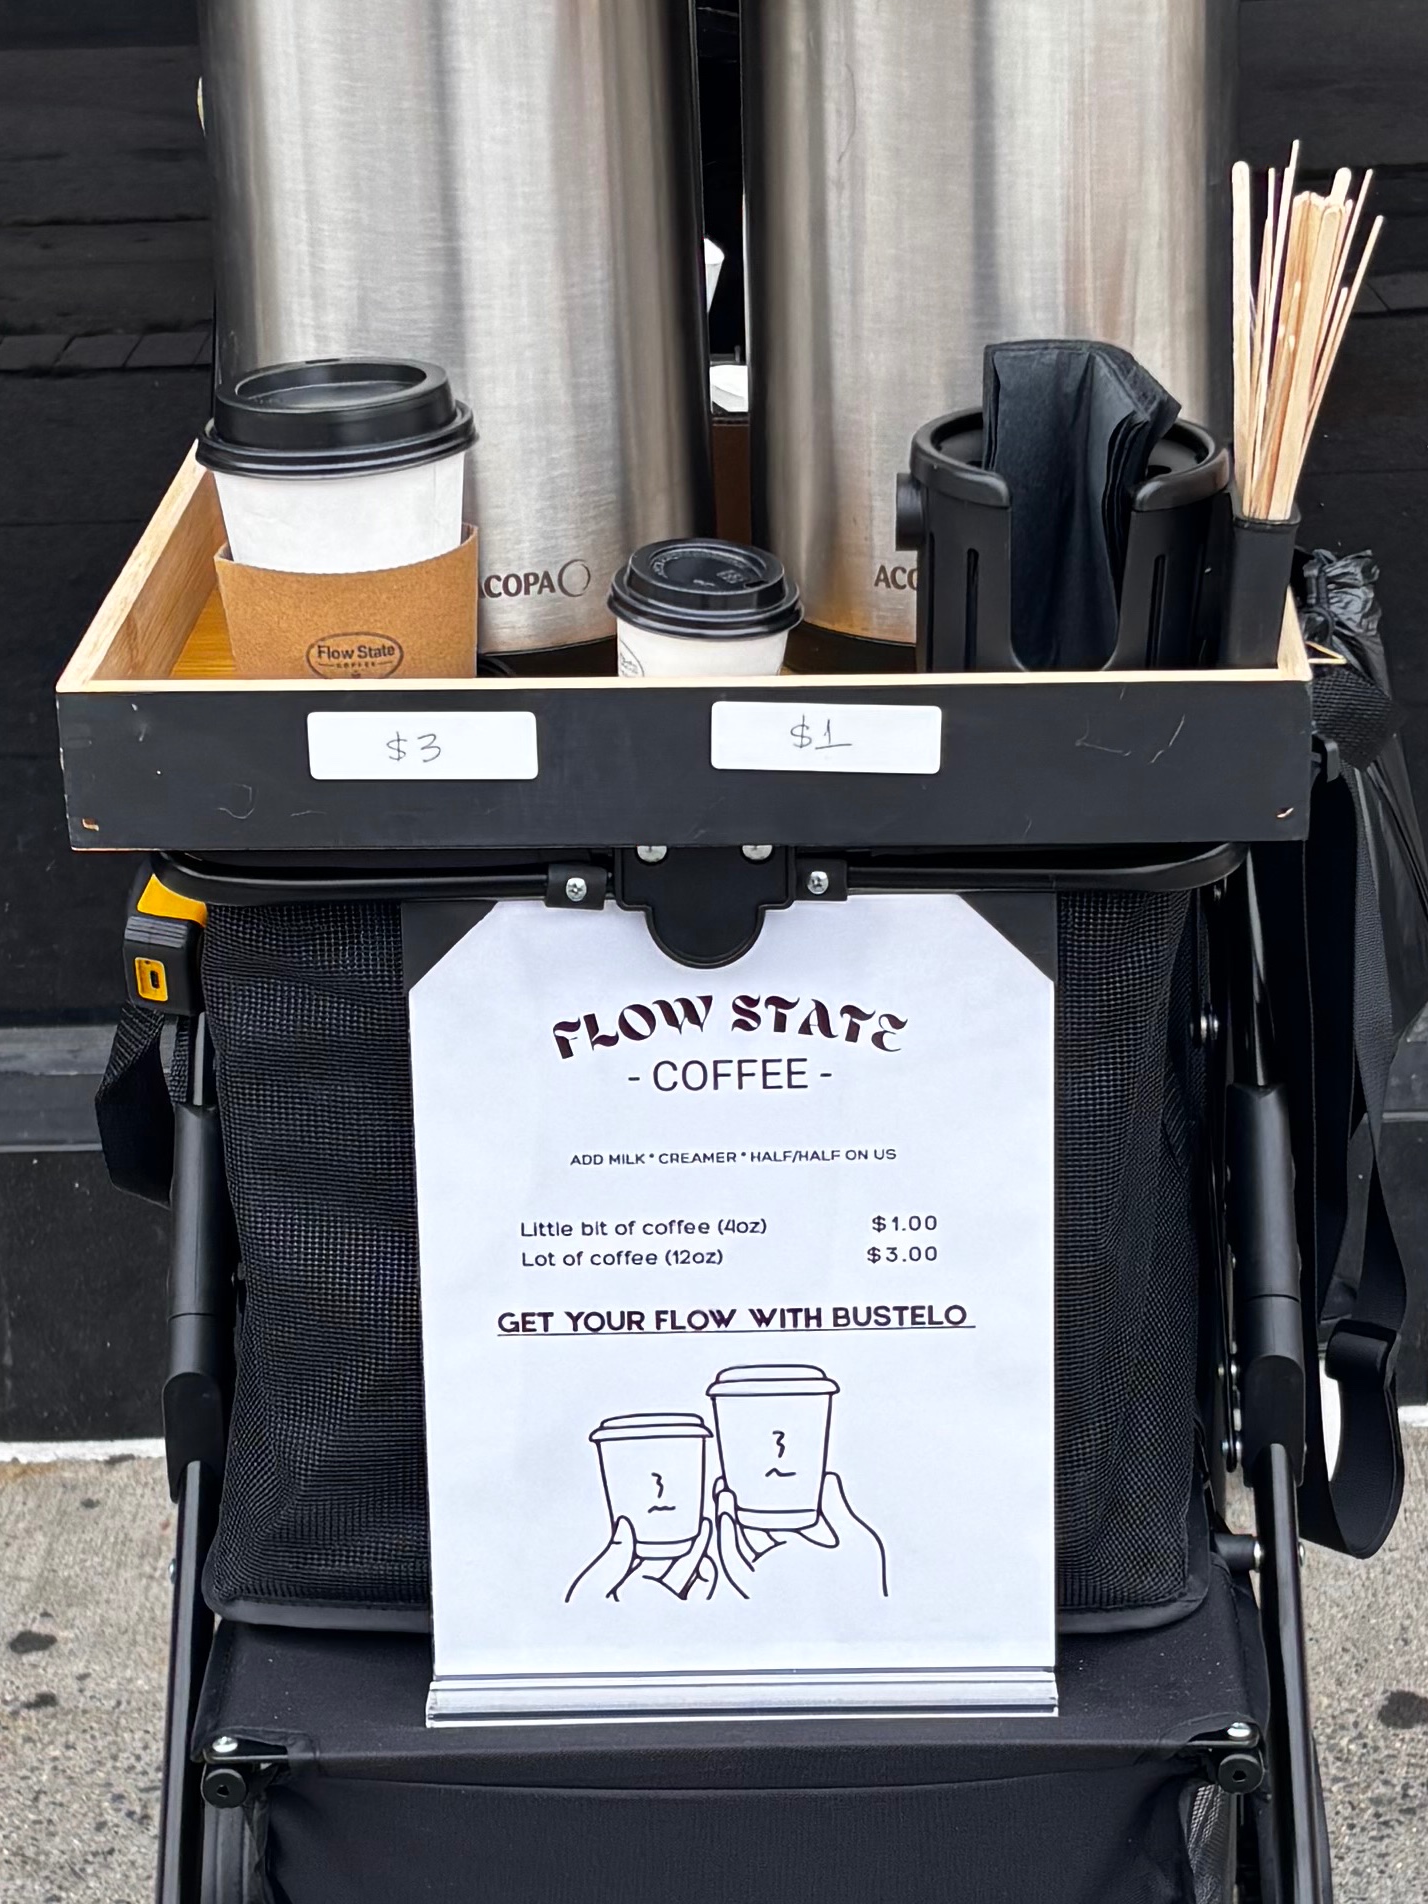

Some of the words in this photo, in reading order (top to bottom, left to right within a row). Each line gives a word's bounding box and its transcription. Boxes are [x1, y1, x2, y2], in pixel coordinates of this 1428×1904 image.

[317, 645, 355, 661] Flow
[357, 644, 395, 659] State
[789, 714, 853, 750] $1
[386, 731, 442, 763] $3
[552, 994, 714, 1060] FLOW
[730, 994, 909, 1053] STATE
[652, 1057, 809, 1092] COFFEE
[569, 1153, 604, 1166] ADD
[608, 1152, 646, 1165] MILK
[658, 1151, 737, 1165] CREAMER
[750, 1149, 841, 1164] HALF/HALF
[845, 1149, 869, 1161] ON
[873, 1148, 897, 1161] US
[520, 1221, 574, 1238] Little
[581, 1221, 609, 1237] bit
[614, 1220, 637, 1236] of
[642, 1219, 711, 1236] coffee
[717, 1218, 767, 1236] (4oz)
[871, 1215, 938, 1234] $1.00
[521, 1251, 556, 1267] Lot
[562, 1250, 584, 1267] of
[589, 1250, 658, 1266] coffee
[664, 1248, 724, 1267] (12oz)
[866, 1245, 938, 1264] $3.00
[497, 1311, 555, 1333] GET
[565, 1310, 646, 1333] YOUR
[654, 1308, 737, 1331] FLOW
[748, 1307, 823, 1330] WITH
[832, 1304, 968, 1328] BUSTELO
